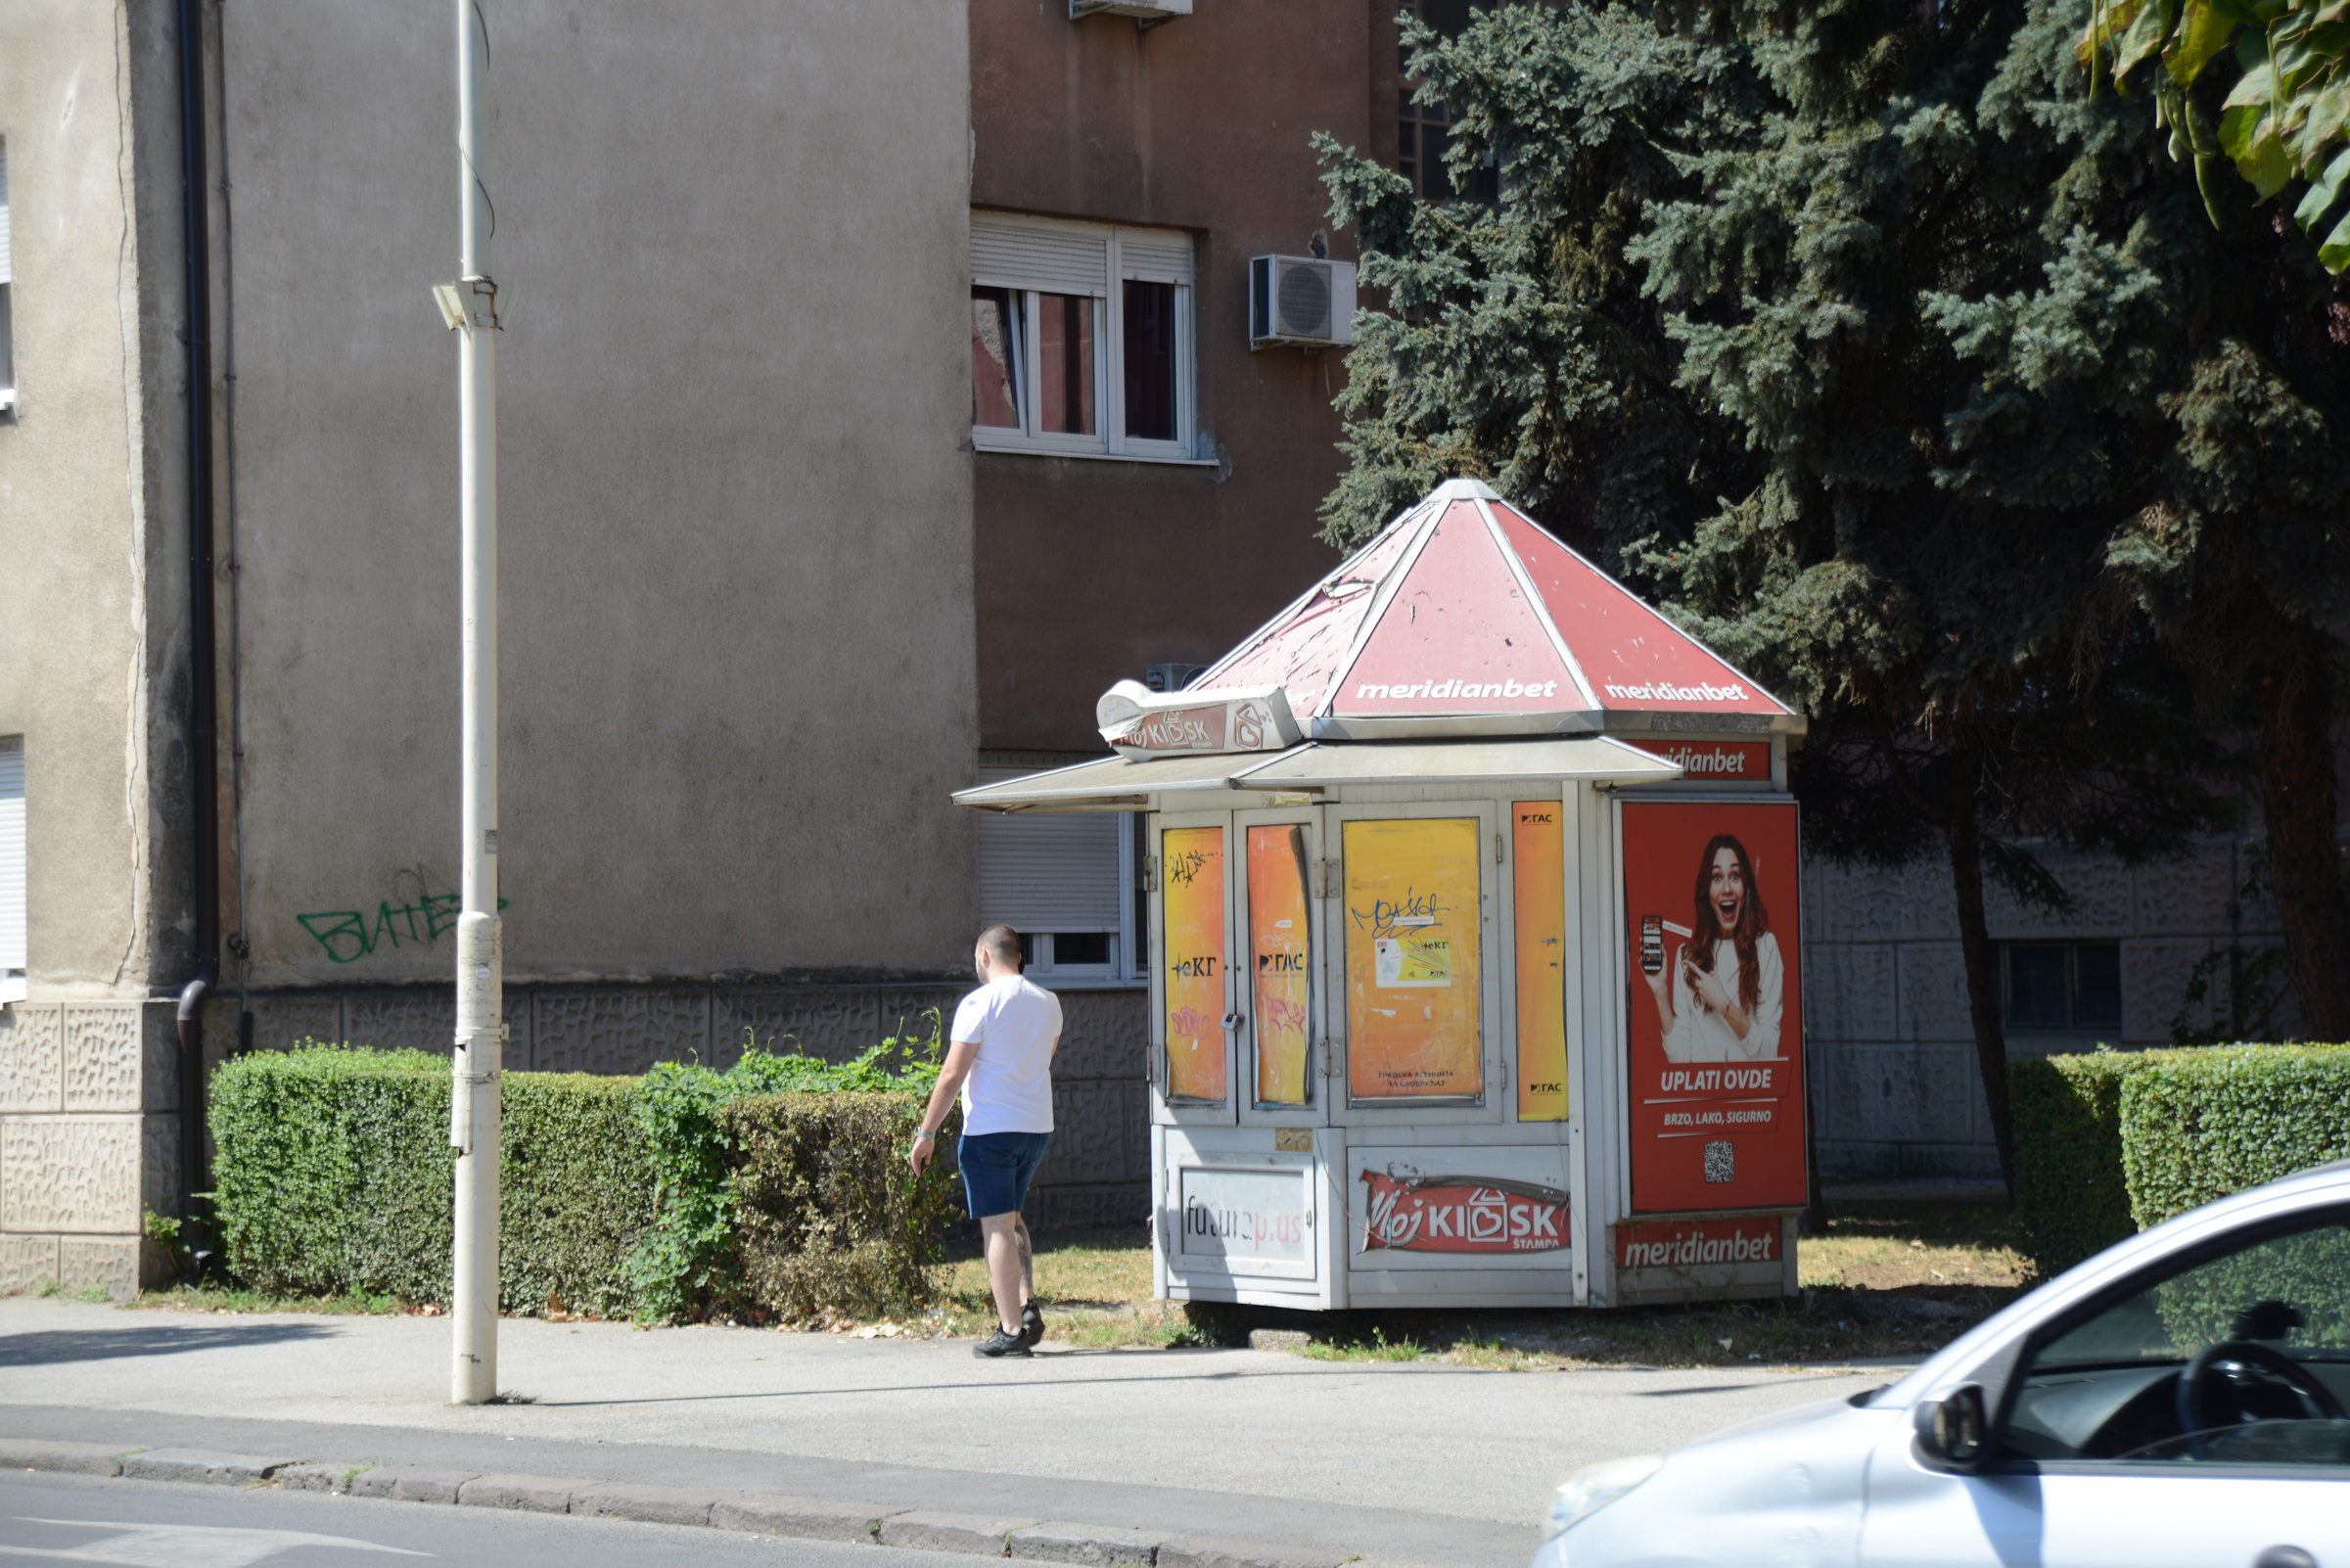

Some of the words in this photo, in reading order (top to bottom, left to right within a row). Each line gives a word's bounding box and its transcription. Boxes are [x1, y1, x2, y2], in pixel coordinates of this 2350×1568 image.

[1357, 679, 1558, 699] meridianbet
[1604, 681, 1750, 701] meridianbet
[1659, 747, 1746, 773] idianbet
[1661, 1070, 1722, 1092] UPLATI
[1724, 1069, 1773, 1090] OVDE
[1664, 1112, 1694, 1126] BRZO,
[1695, 1112, 1725, 1125] LAKO,
[1727, 1110, 1772, 1124] SIGURNO
[1428, 1188, 1559, 1243] KIOSK
[1625, 1229, 1773, 1268] meridianbet
